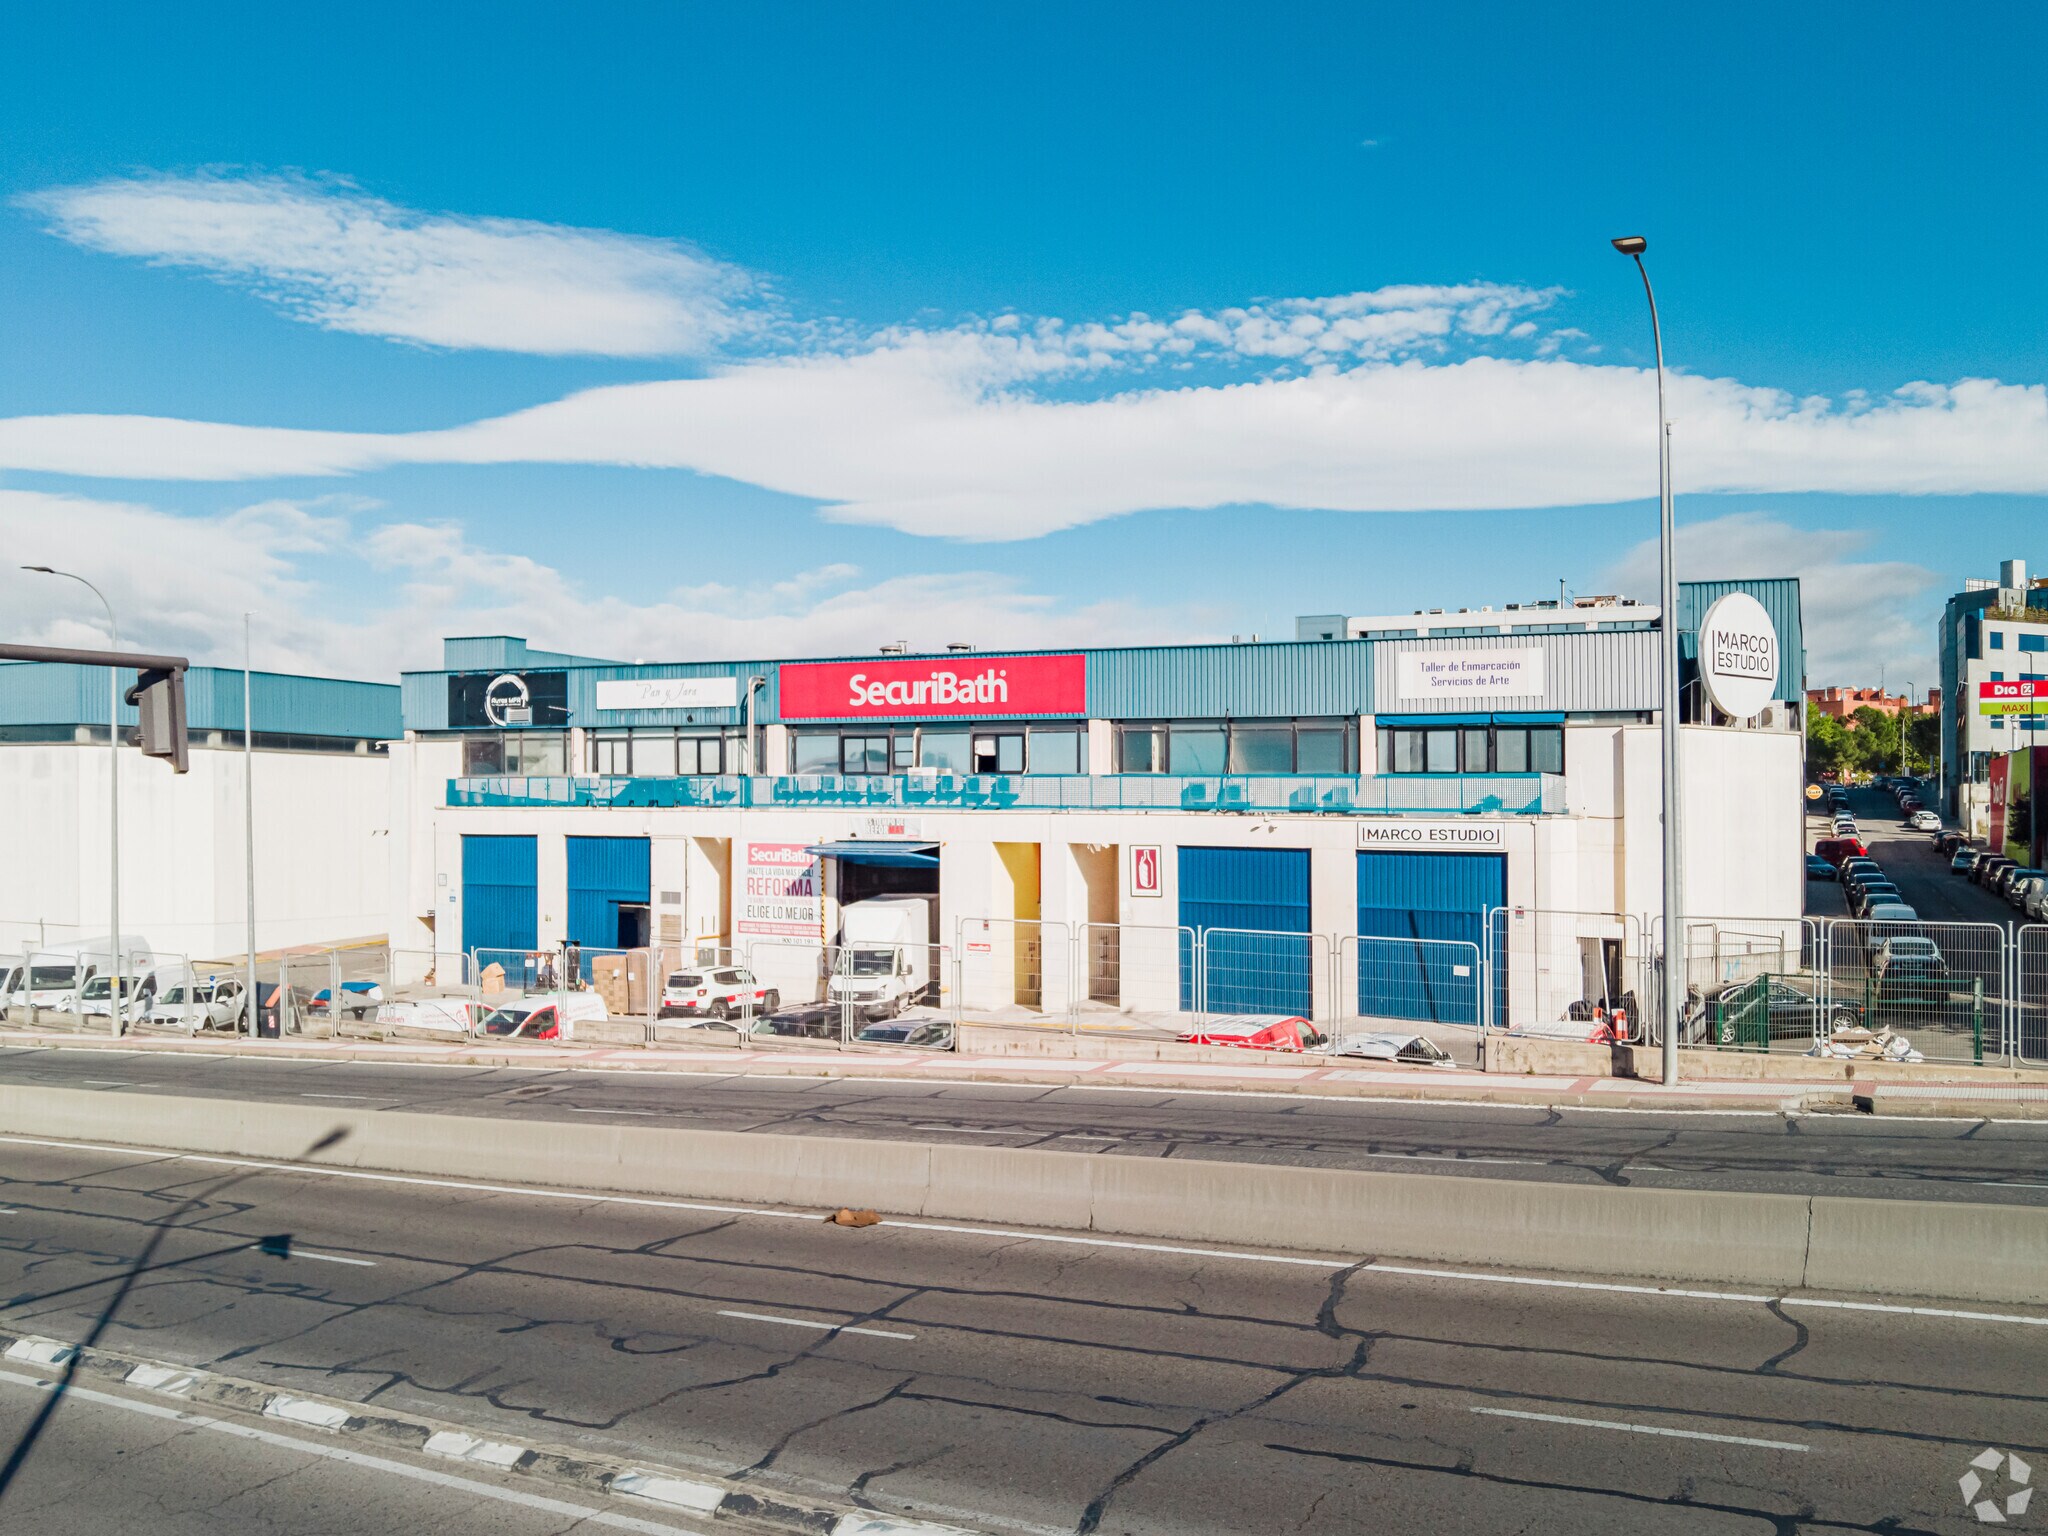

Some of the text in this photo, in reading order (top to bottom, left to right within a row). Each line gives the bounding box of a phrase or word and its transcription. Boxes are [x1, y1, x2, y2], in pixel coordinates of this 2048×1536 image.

[1717, 630, 1769, 654] MARCO
[1420, 660, 1521, 672] Taller de Enmarcación
[1718, 651, 1770, 672] ESTUDIO
[849, 669, 1008, 707] SecuriBath
[1431, 675, 1510, 687] Servicios de Arte
[2001, 704, 2029, 712] MAXI
[1367, 828, 1494, 842] MARCO ESTUDIO
[747, 877, 813, 897] REFORMA
[747, 904, 814, 921] ELIGE LO MEJOR
